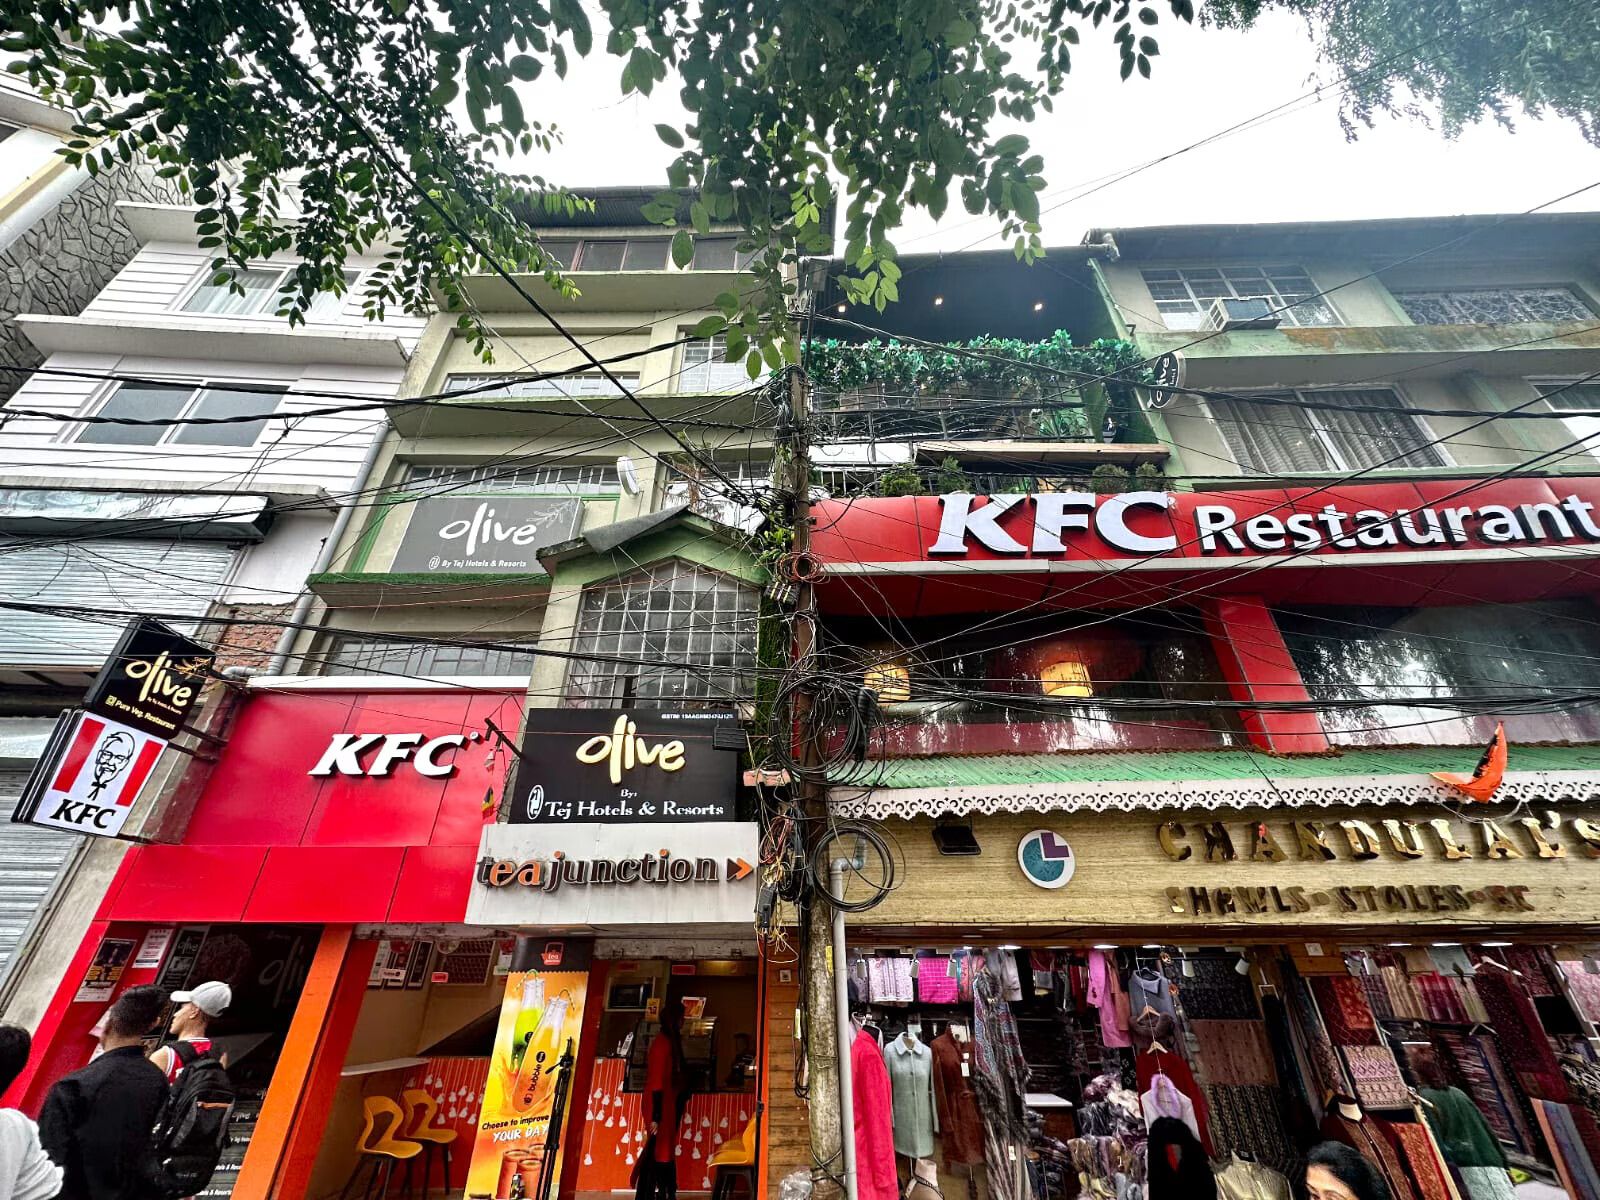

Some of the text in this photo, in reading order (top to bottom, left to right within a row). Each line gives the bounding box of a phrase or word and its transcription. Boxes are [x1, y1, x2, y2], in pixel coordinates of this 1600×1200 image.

[439, 502, 537, 556] olive
[928, 491, 1600, 553] KFC Restaurant
[442, 560, 451, 568] By
[453, 560, 464, 568] Tej
[465, 559, 489, 567] Hotels
[125, 650, 192, 707] olive
[115, 700, 131, 711] Pure
[144, 712, 176, 730] Restaurant
[307, 732, 467, 778] KFC
[576, 714, 686, 784] olive
[49, 799, 117, 829] KFC
[545, 800, 724, 819] Tej Hotels & Resorts
[528, 1064, 542, 1091] bubble
[492, 1124, 550, 1144] YOUR DAY
[511, 1117, 519, 1127] to
[520, 1114, 550, 1128] improve
